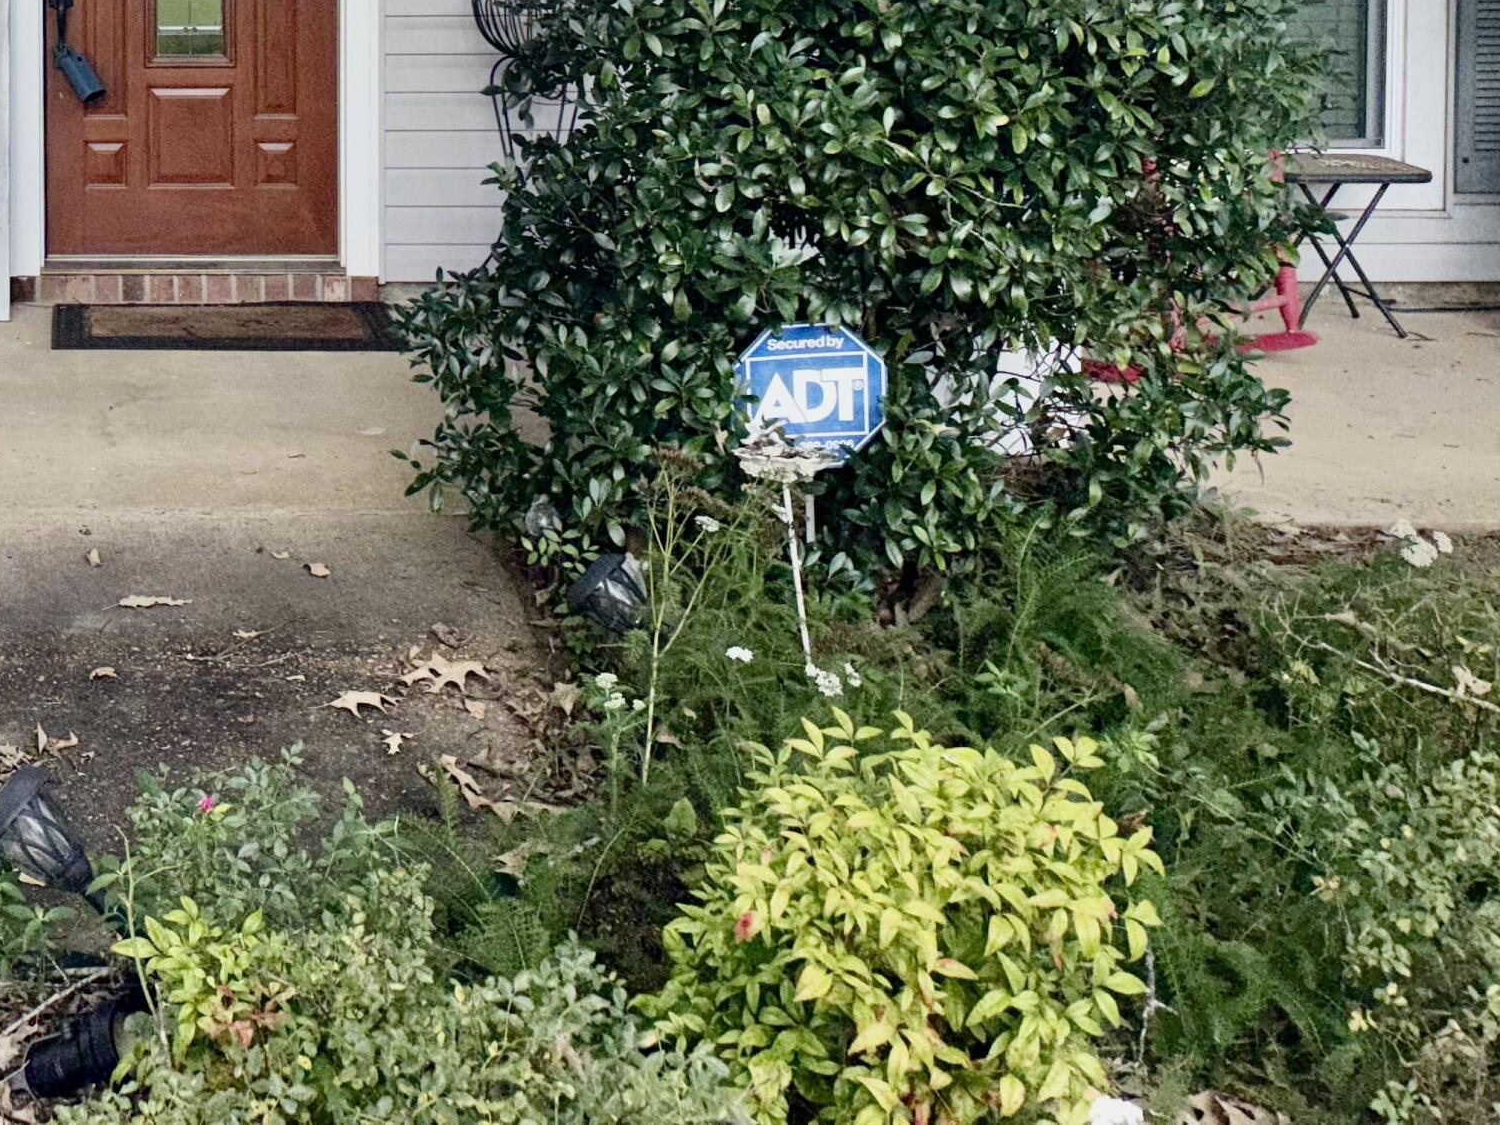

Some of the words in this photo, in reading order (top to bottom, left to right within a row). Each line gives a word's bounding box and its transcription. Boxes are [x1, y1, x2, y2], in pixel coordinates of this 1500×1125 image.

[767, 336, 825, 351] Secured
[826, 335, 844, 349] by
[754, 367, 864, 424] ADT
